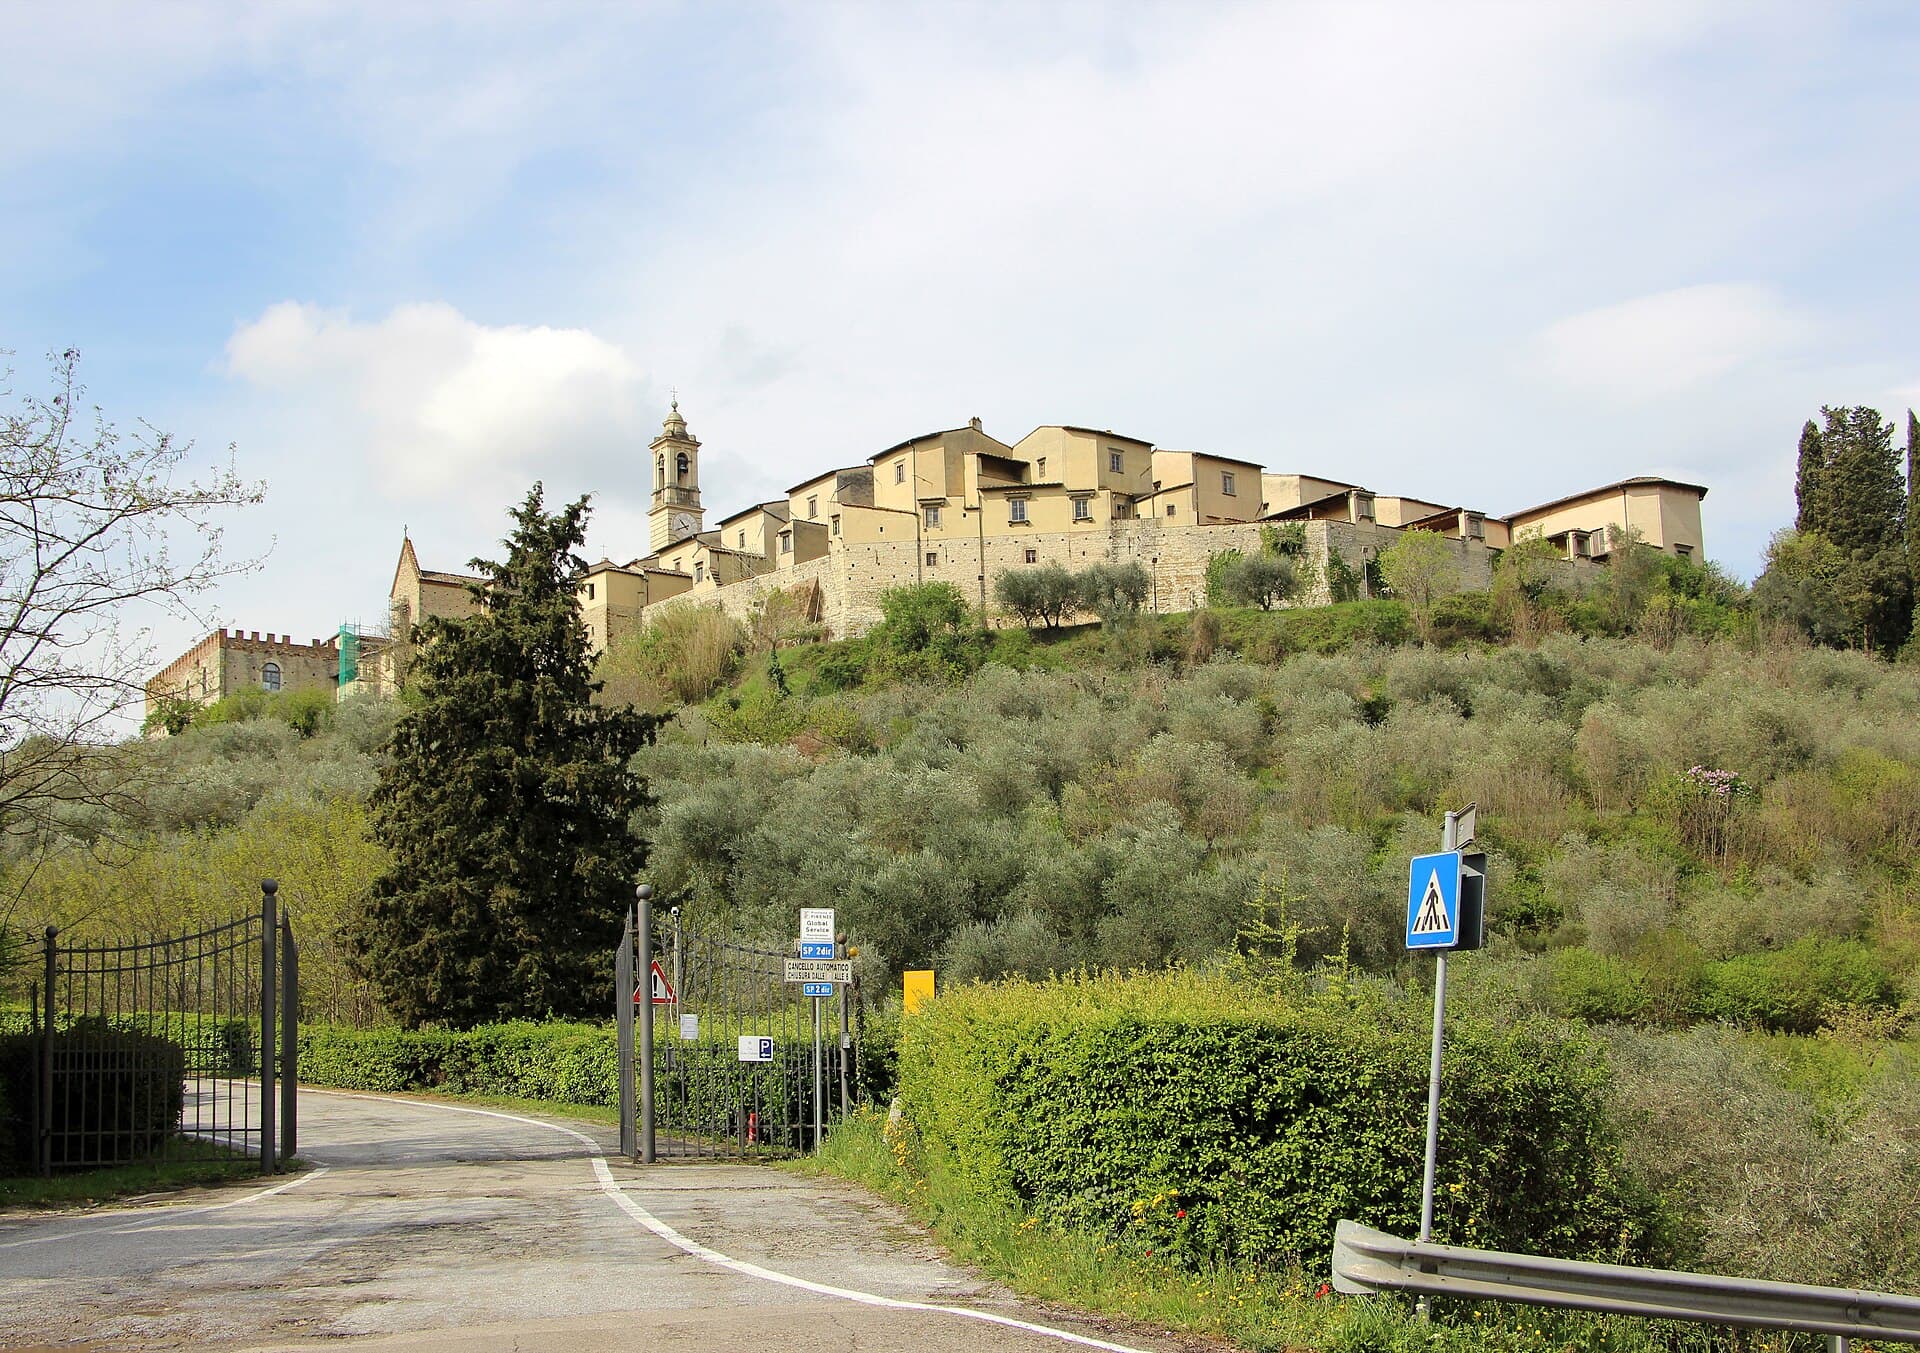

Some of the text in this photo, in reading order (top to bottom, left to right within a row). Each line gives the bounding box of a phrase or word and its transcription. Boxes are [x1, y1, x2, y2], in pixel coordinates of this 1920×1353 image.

[803, 946, 813, 955] SP
[788, 962, 814, 970] CANCELLO
[812, 972, 824, 980] DALLE
[761, 1040, 770, 1052] P
